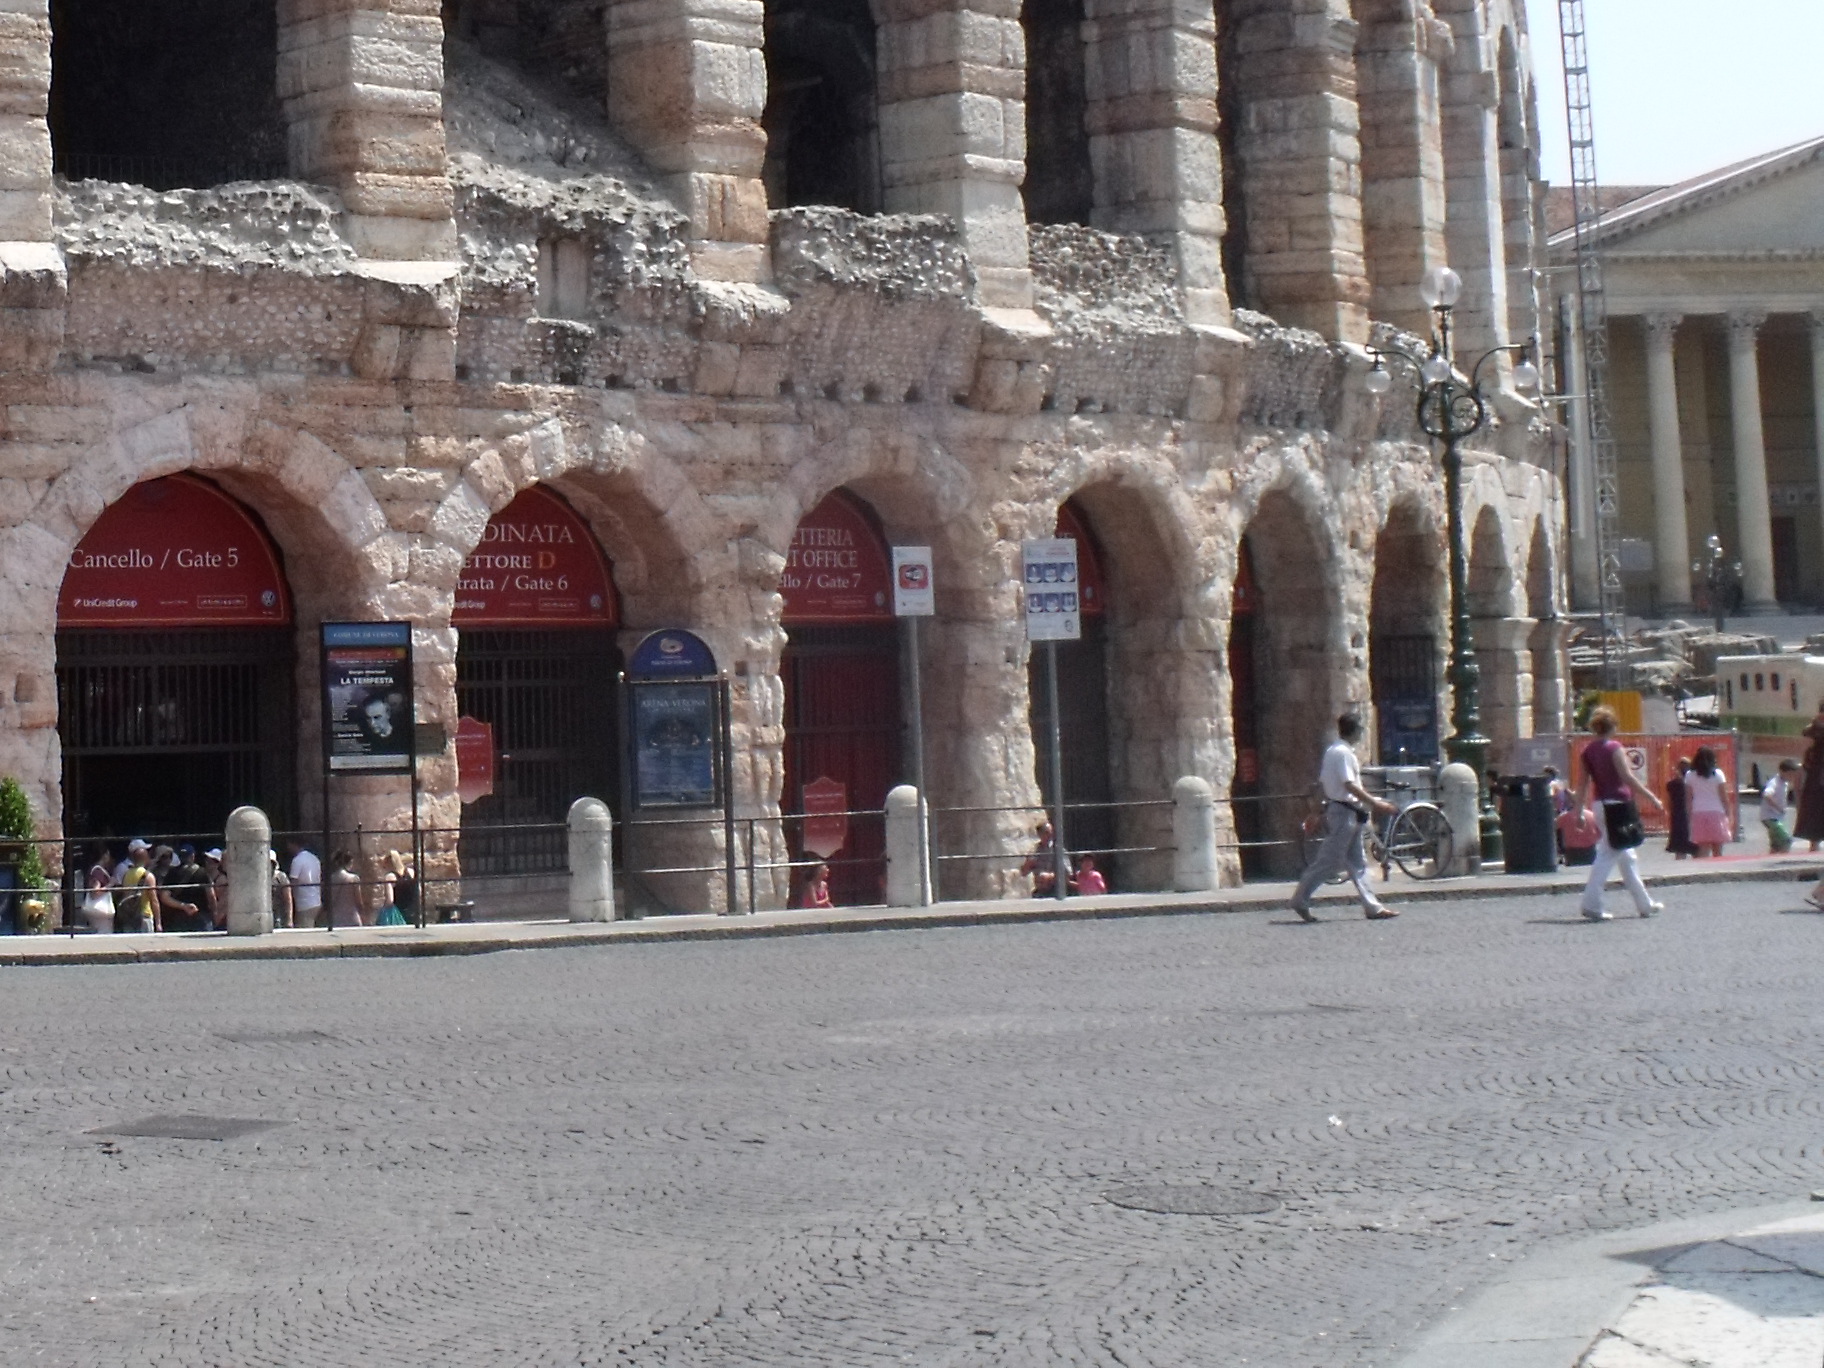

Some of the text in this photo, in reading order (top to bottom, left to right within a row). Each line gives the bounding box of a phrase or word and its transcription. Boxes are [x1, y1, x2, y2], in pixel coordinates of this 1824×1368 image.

[482, 523, 575, 543] DINATA
[69, 548, 153, 568] Cancello
[177, 548, 221, 568] Gate
[227, 547, 239, 568] 5
[465, 551, 556, 570] ETTORE D
[802, 550, 858, 568] OFFICE
[457, 576, 495, 590] trata
[515, 574, 555, 590] Gate
[558, 574, 569, 590] 6
[817, 574, 850, 588] Gate
[852, 573, 862, 588] 7
[340, 676, 394, 685] LA TEMPESTA
